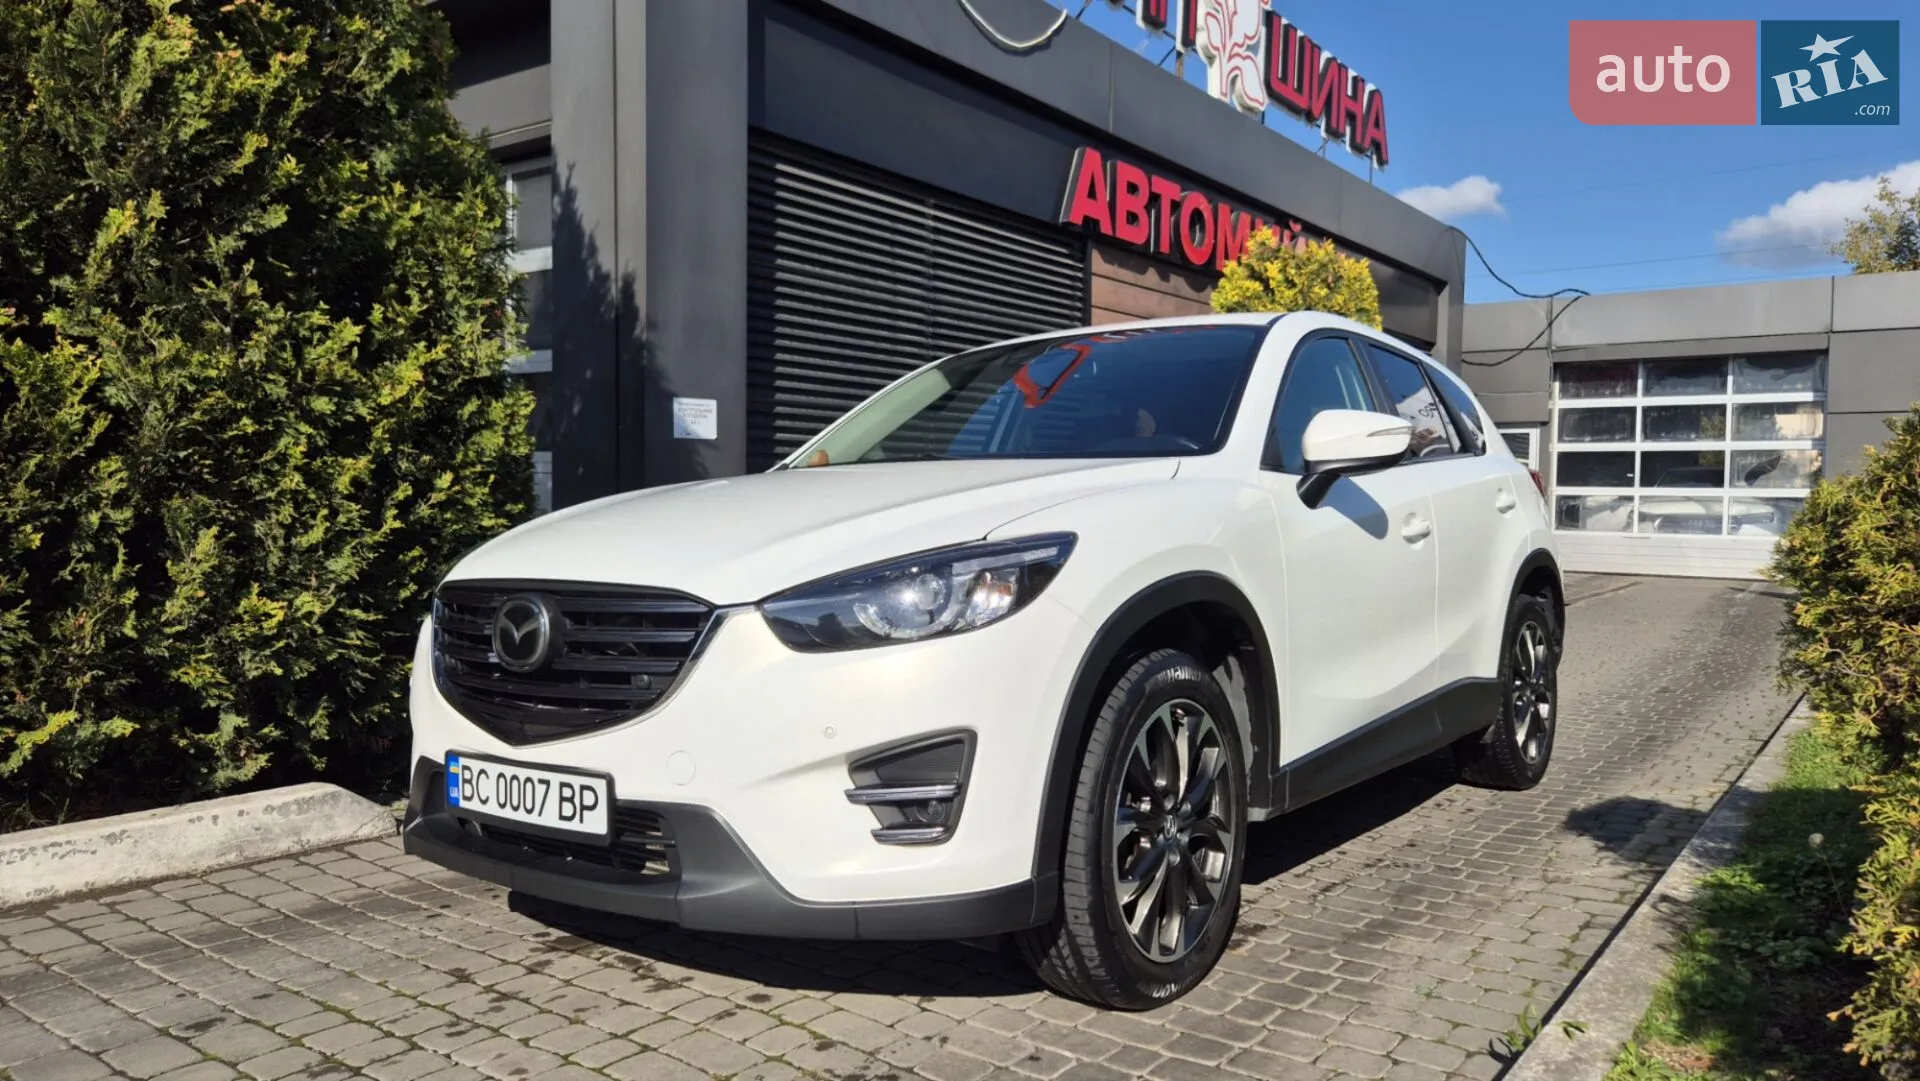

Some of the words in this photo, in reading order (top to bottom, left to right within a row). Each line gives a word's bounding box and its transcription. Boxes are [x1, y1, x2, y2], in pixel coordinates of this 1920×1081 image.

[1266, 11, 1388, 167] ШИНА
[1067, 147, 1308, 271] АВТОМ
[461, 764, 490, 805] BC
[496, 772, 551, 817] 0007
[558, 781, 599, 824] BP
